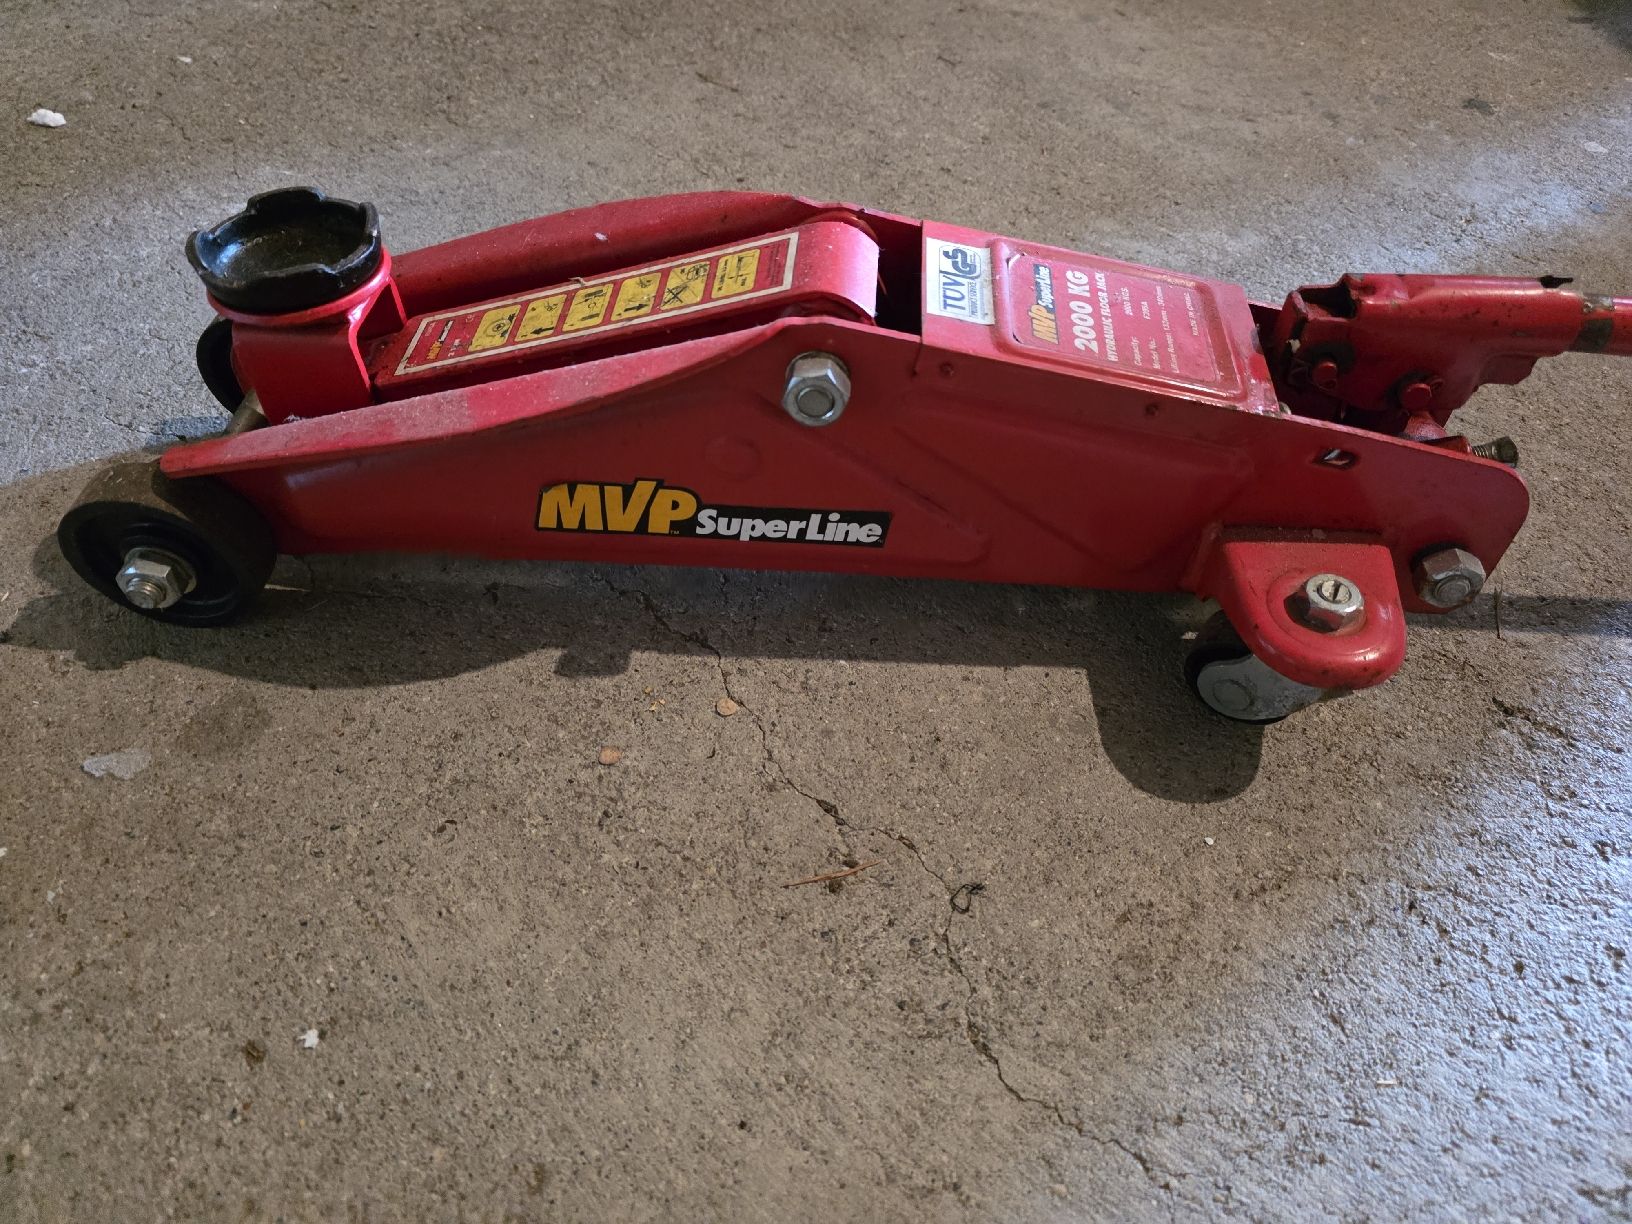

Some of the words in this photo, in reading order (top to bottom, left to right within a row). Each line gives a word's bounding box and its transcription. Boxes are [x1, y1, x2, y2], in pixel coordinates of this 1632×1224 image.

[1065, 270, 1091, 298] KG
[1094, 271, 1107, 292] JACK
[1028, 304, 1059, 345] MVP
[1097, 291, 1112, 317] FLOOR
[1068, 300, 1099, 354] 2000
[1101, 316, 1119, 362] HYDRAULIC
[538, 480, 698, 535] MVP
[695, 508, 883, 543] SuperLine
